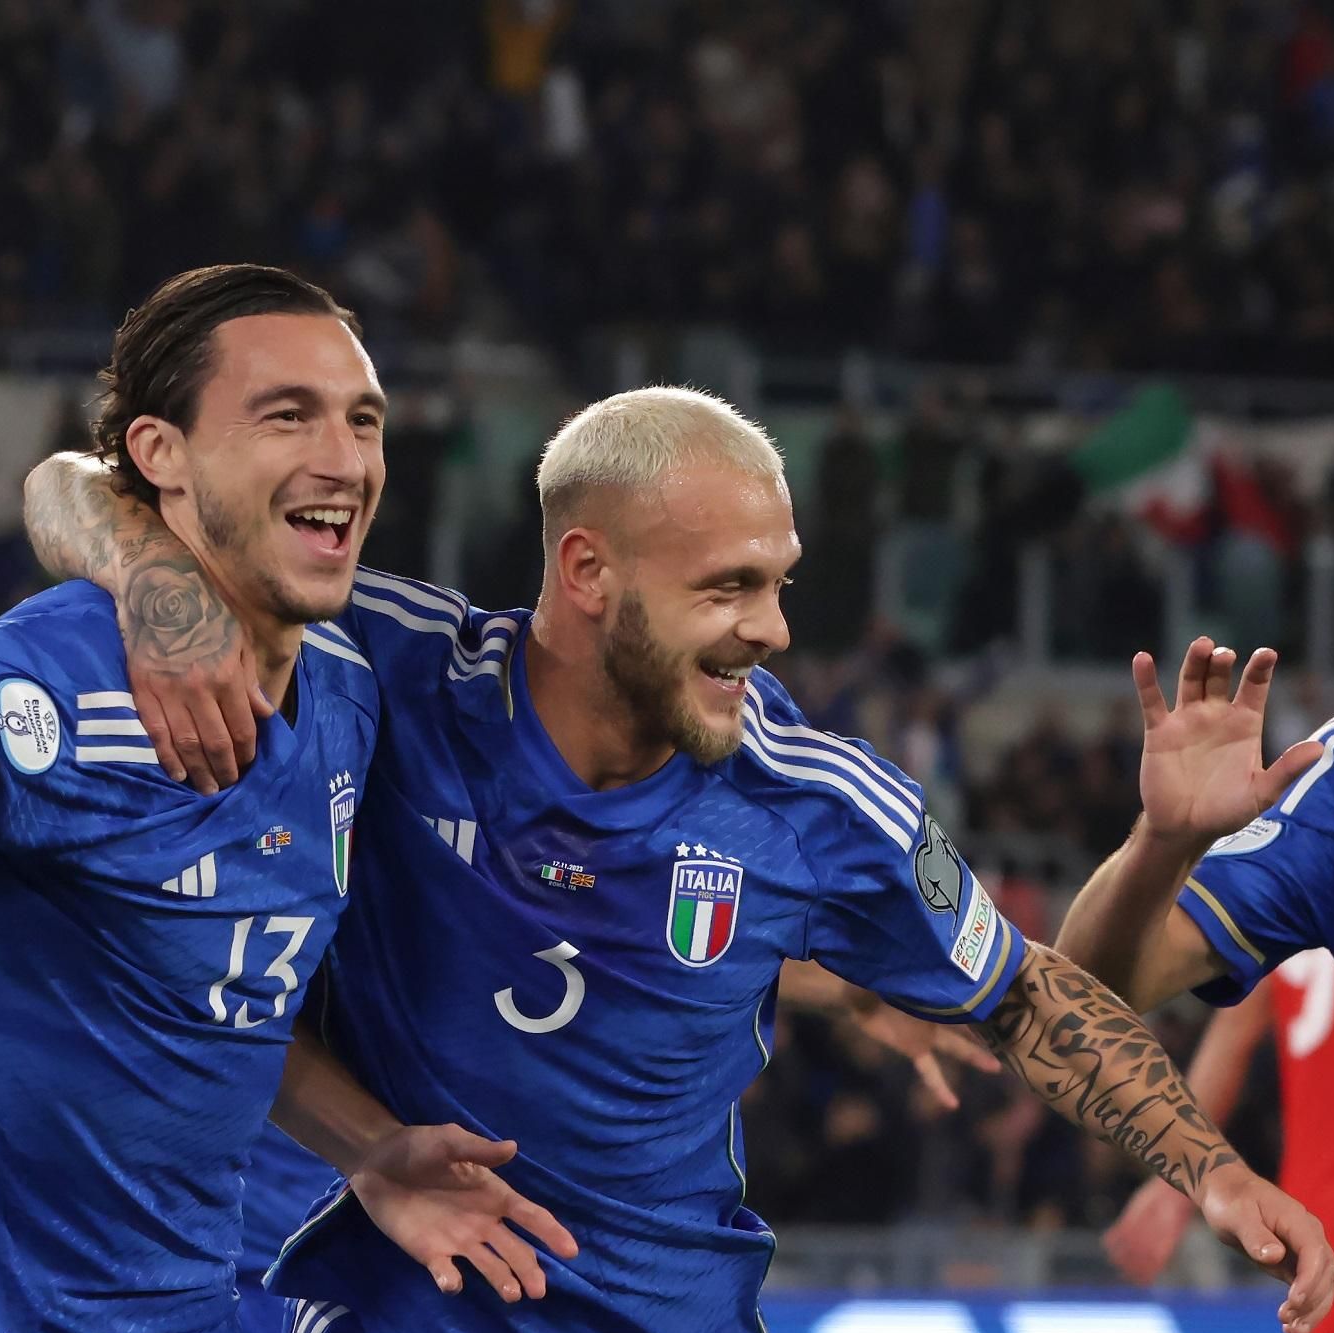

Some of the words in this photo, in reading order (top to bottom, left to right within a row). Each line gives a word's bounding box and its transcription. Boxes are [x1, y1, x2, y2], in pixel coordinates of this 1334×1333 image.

[24, 699, 42, 753] CHAMPIONS
[32, 699, 49, 754] EUROPEAN
[678, 868, 735, 893] ITALIA
[697, 890, 715, 900] FIGC
[208, 916, 316, 1029] 13
[954, 935, 968, 962] UEFA
[494, 940, 586, 1034] 3
